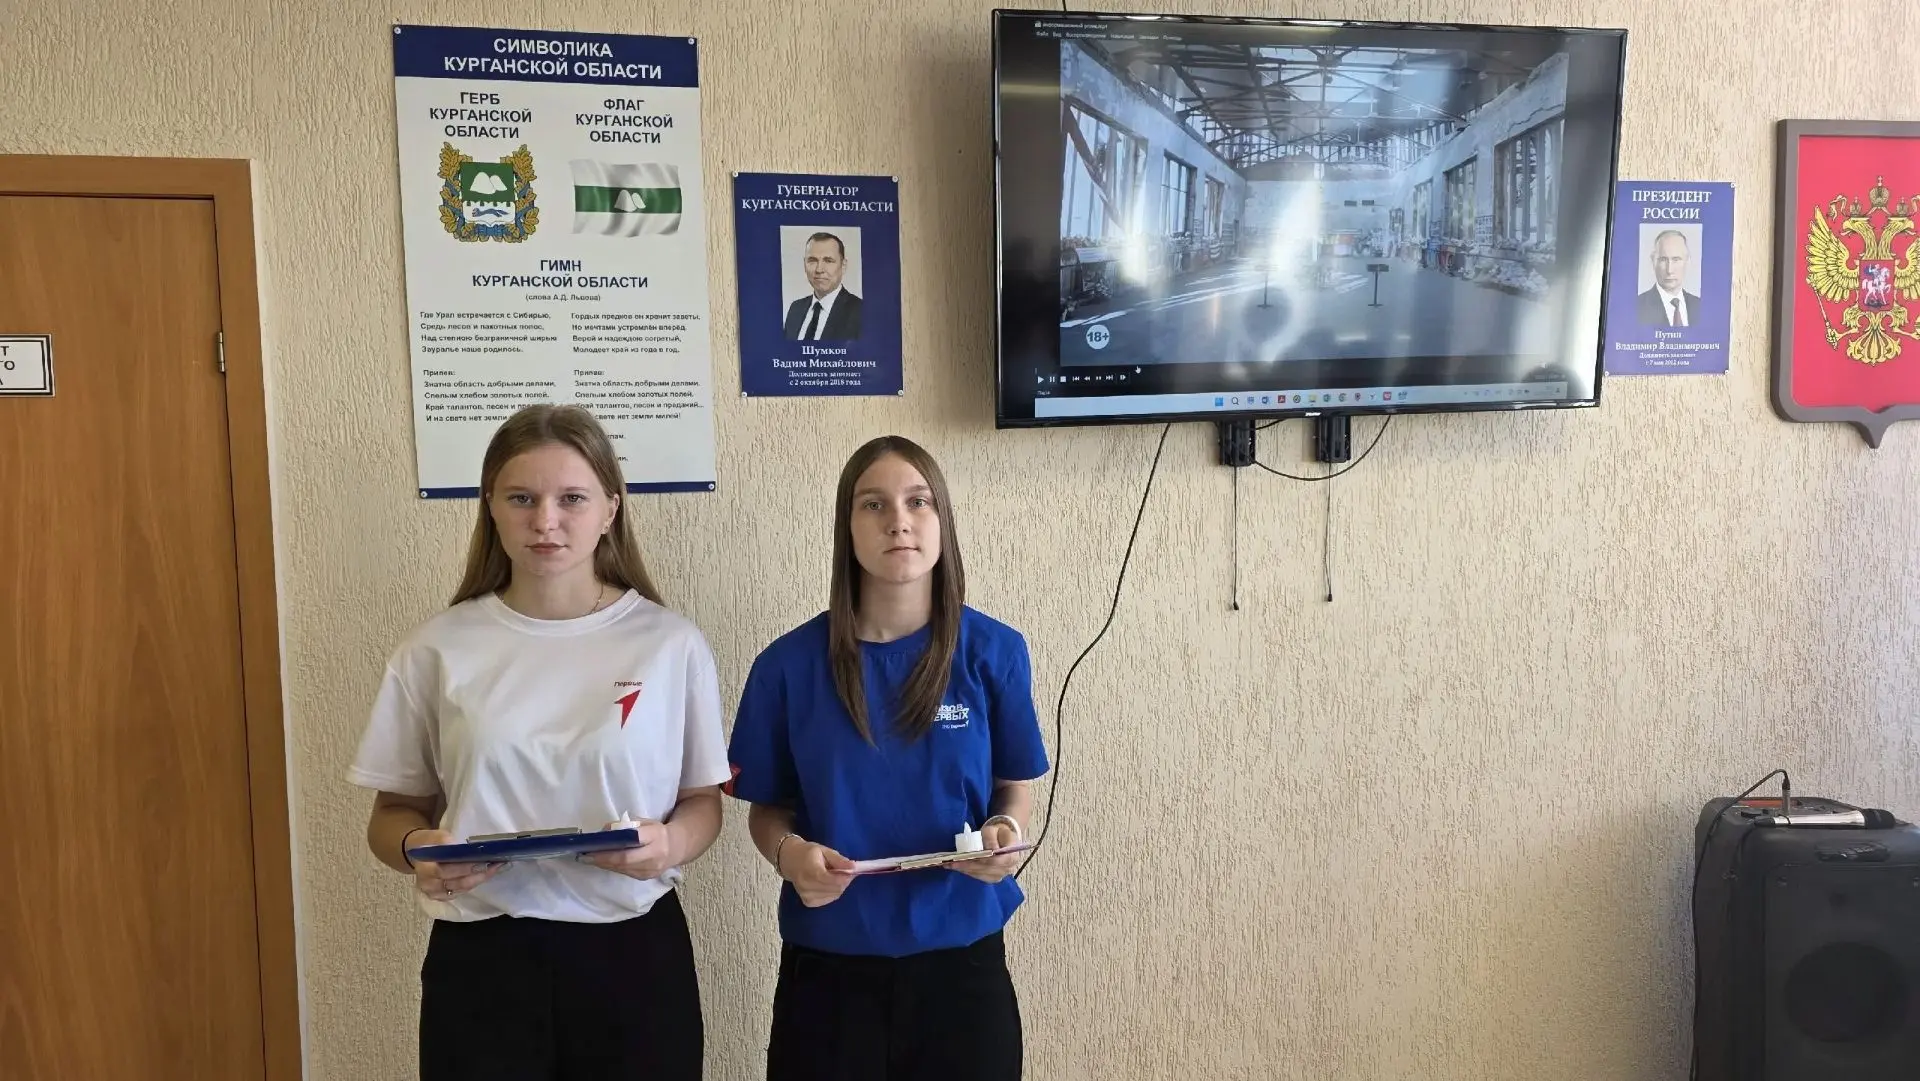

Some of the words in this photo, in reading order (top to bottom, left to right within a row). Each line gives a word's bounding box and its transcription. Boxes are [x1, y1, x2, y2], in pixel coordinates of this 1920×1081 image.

[494, 39, 613, 57] СИМВОЛИКА
[445, 57, 568, 75] КУРГАНСКОЙ
[574, 62, 662, 79] ОБЛАСТИ
[460, 92, 500, 104] ГЕРБ
[604, 99, 645, 111] ФЛАГ
[430, 107, 532, 123] КУРГАНСКОЙ
[576, 114, 673, 128] КУРГАНСКОЙ
[445, 125, 519, 138] ОБЛАСТИ
[590, 131, 660, 144] ОБЛАСТИ
[777, 185, 858, 196] ГУБЕРНАТОР
[1632, 190, 1711, 204] ПРЕЗИДЕНТ
[742, 199, 830, 211] КУРГАНСКОЙ
[833, 201, 893, 212] ОБЛАСТИ
[1643, 208, 1700, 219] РОССИИ
[541, 260, 581, 271] ГИМН
[473, 274, 572, 287] КУРГАНСКОЙ
[578, 277, 648, 288] ОБЛАСТИ
[1087, 331, 1109, 343] 18+
[1655, 331, 1682, 340] Путин
[422, 346, 459, 354] Зауралье
[802, 346, 847, 356] Шумков
[1616, 342, 1657, 351] Владимир
[1659, 342, 1719, 351] Владимирович
[773, 359, 806, 368] Вадим
[809, 359, 876, 368] Михайлович
